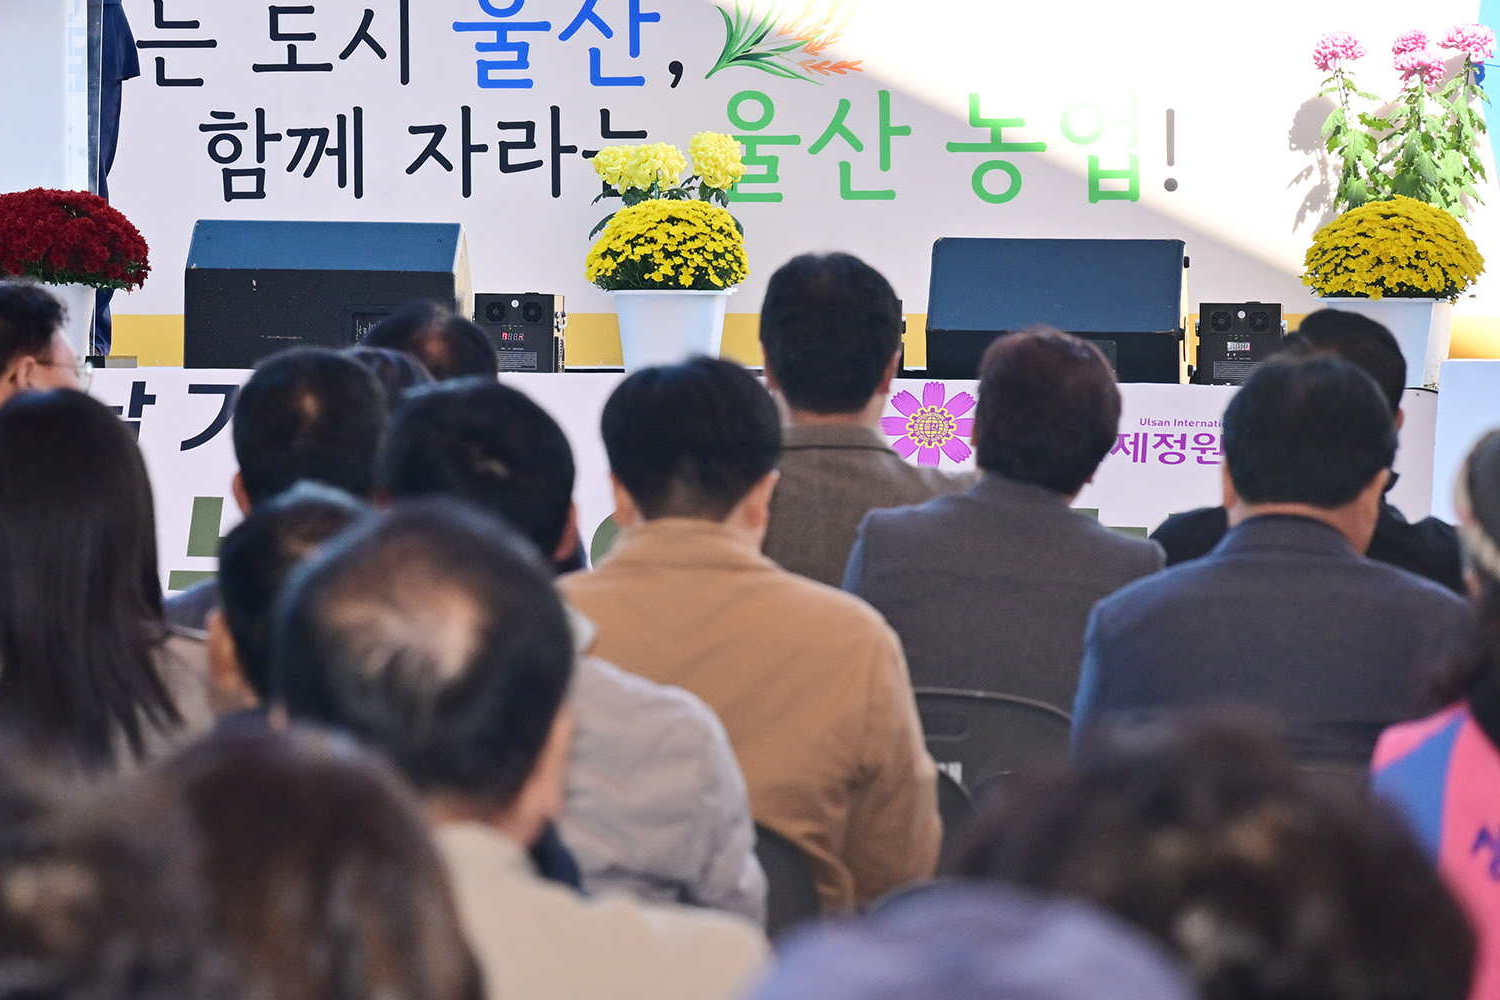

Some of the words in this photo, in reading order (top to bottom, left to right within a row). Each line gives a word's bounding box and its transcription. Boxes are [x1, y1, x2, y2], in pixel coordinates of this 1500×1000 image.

[135, 0, 217, 88] 는
[199, 105, 364, 203] 함께
[727, 89, 911, 203] 울산
[946, 88, 1178, 204] 농업!
[1109, 432, 1225, 465] 제정원
[1140, 418, 1170, 427] Ulsan
